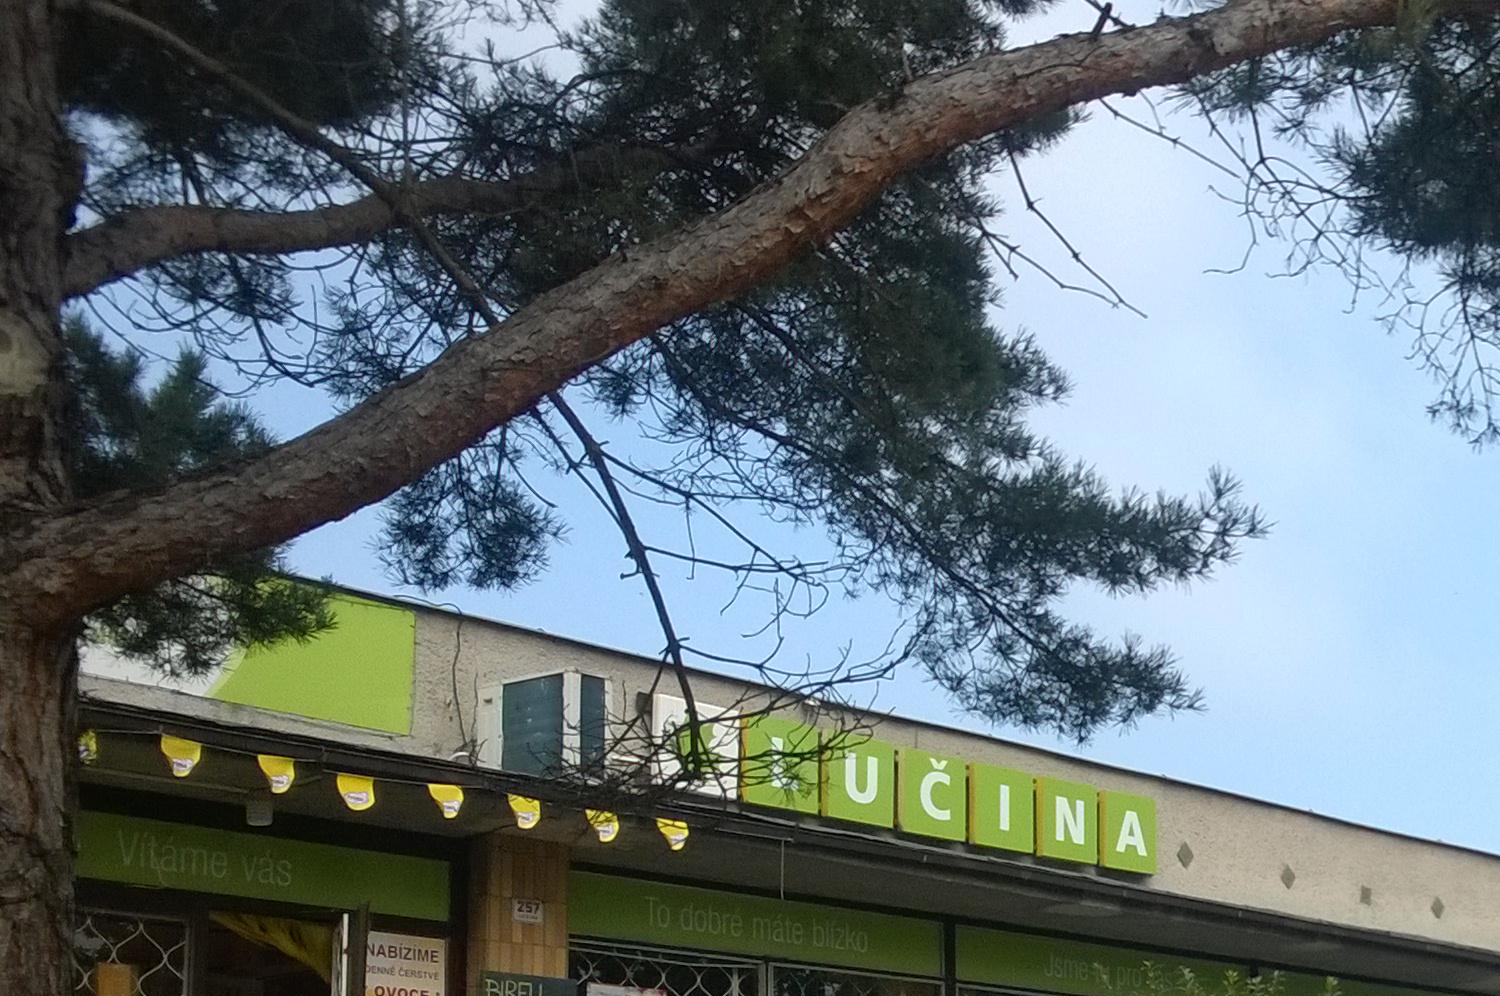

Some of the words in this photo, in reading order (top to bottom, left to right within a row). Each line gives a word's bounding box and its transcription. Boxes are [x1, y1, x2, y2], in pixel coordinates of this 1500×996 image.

[117, 828, 228, 878] Vítáme
[242, 850, 292, 887] vás
[516, 900, 541, 915] 257
[645, 895, 670, 929] To
[680, 902, 744, 937] dobré
[752, 913, 804, 944] máte
[812, 917, 869, 953] blízko
[366, 943, 440, 963] NABÍZÍME
